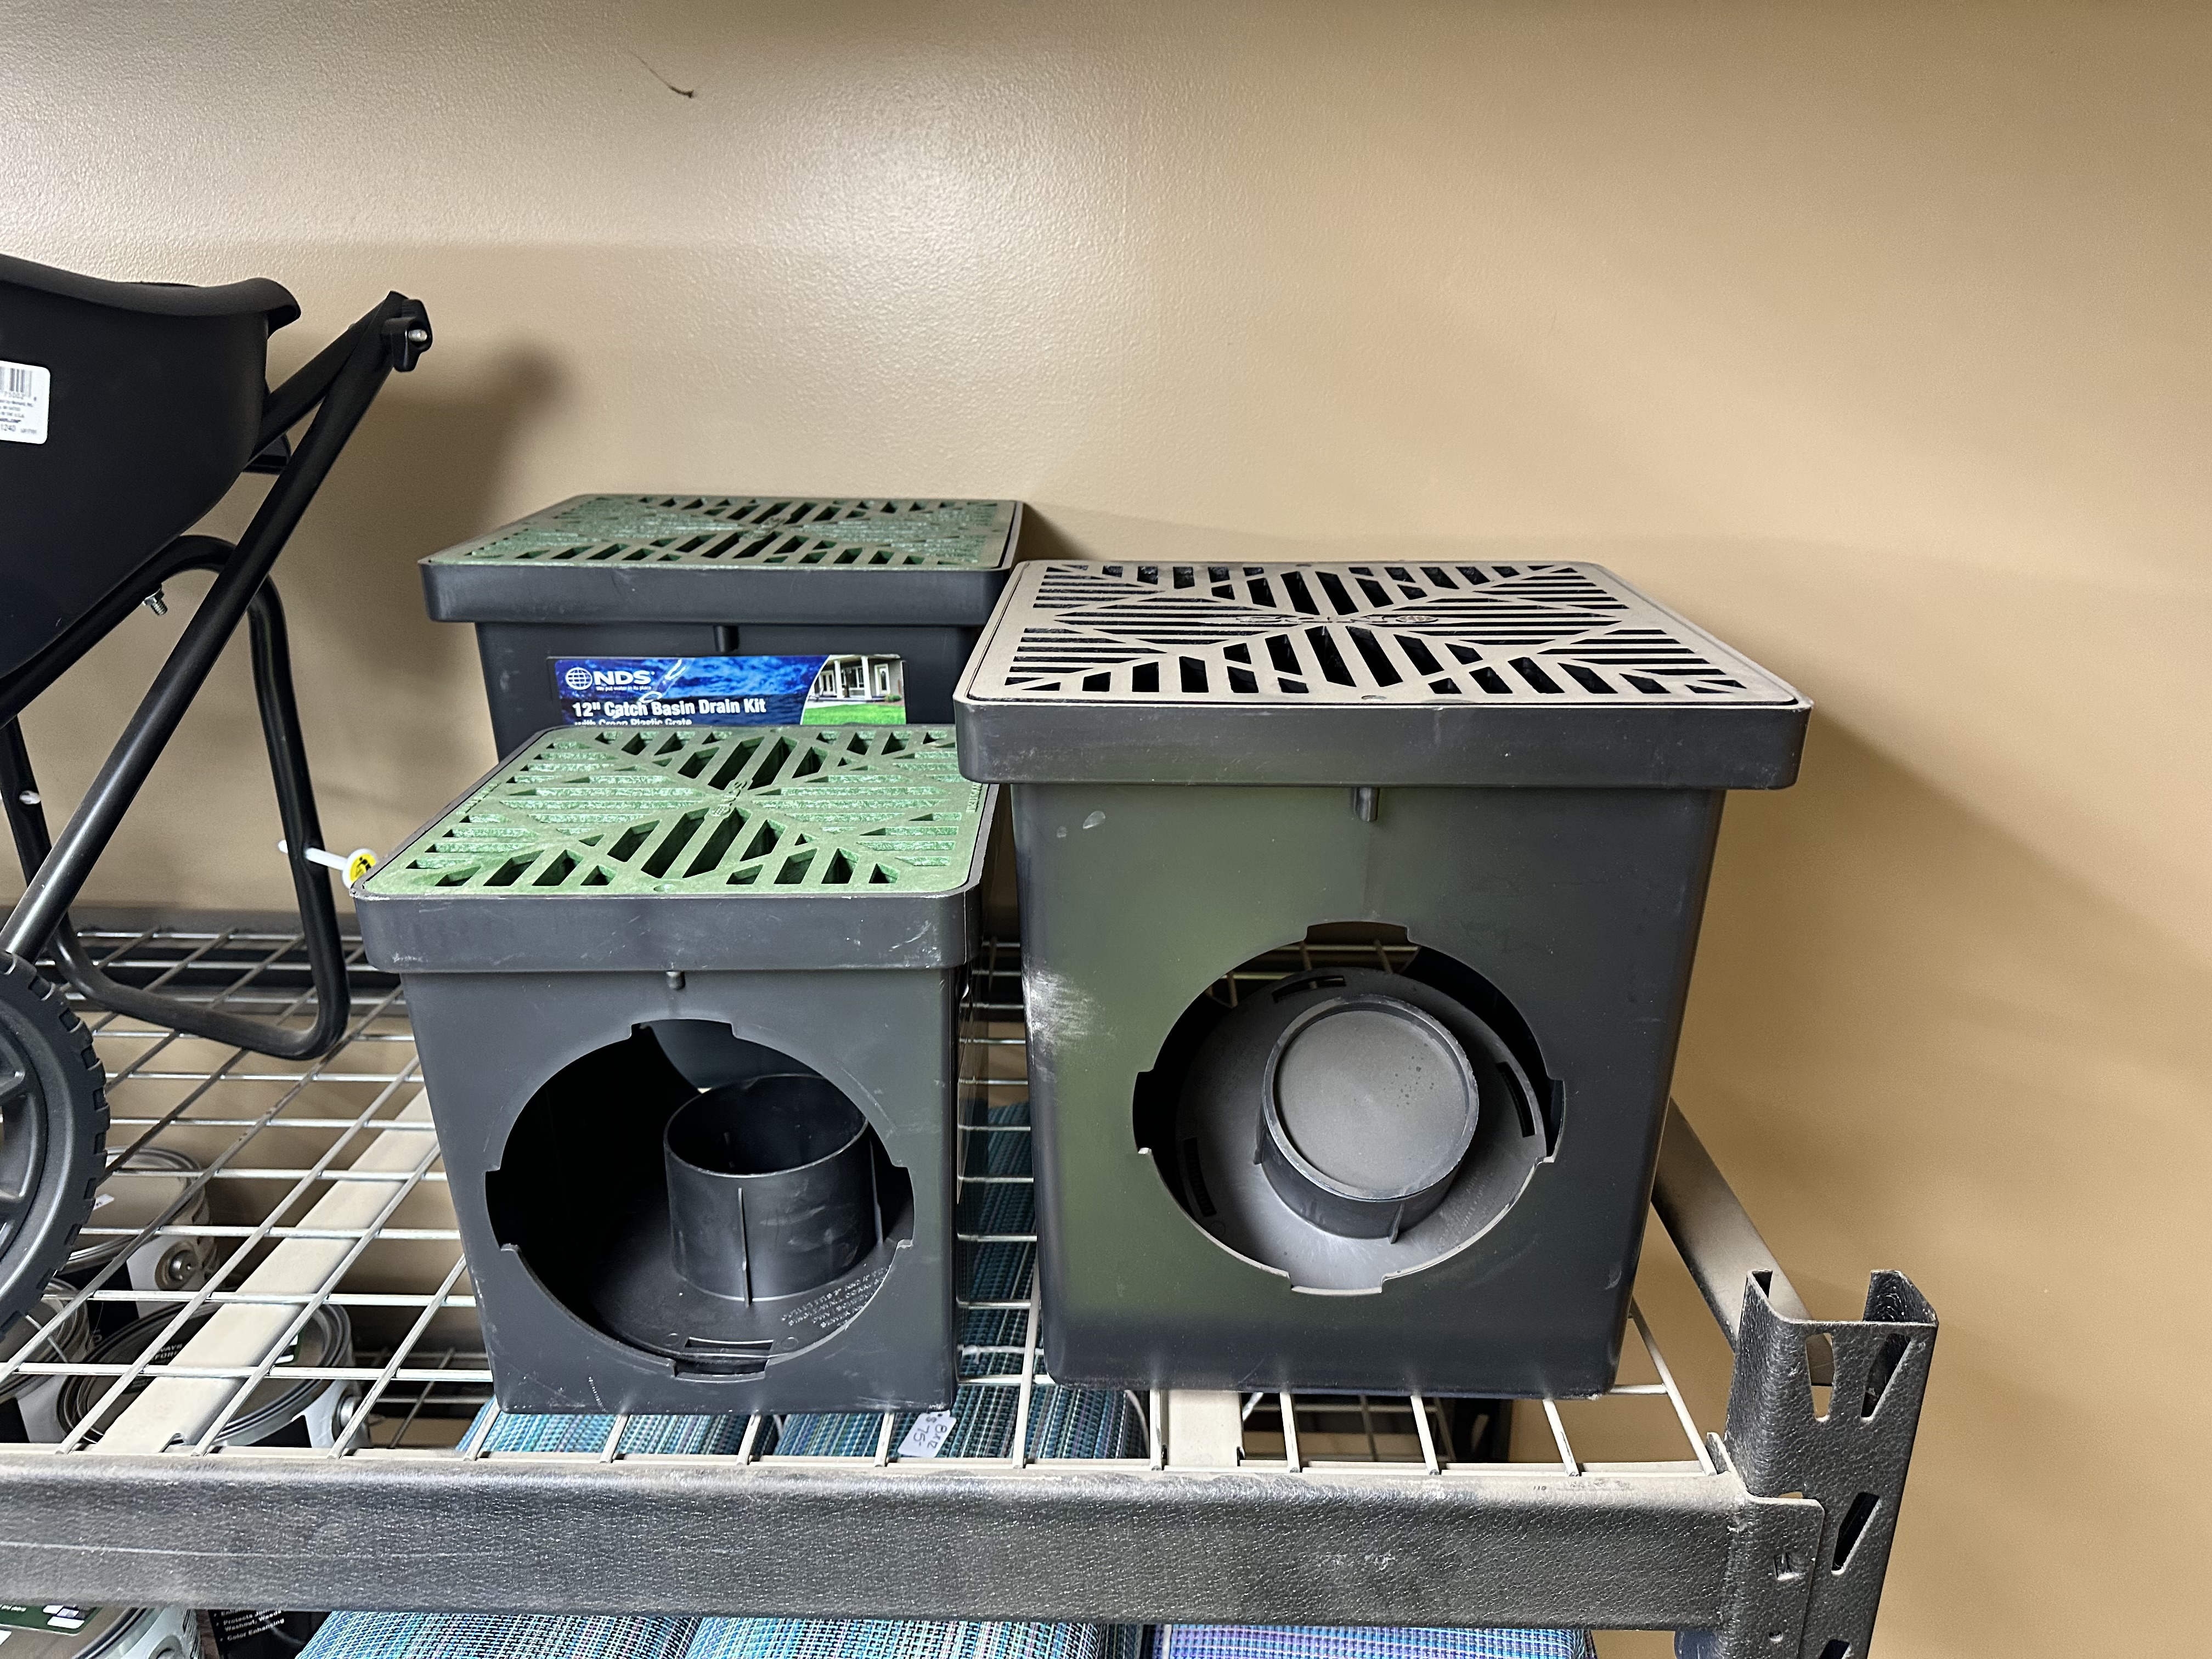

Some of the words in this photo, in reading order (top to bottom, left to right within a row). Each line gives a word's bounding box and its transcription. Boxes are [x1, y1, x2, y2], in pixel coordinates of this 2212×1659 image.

[593, 670, 651, 685] NDS
[572, 702, 601, 717] 12"
[604, 701, 648, 717] Catch
[651, 700, 696, 716] Basin
[698, 698, 740, 714] Drain
[743, 698, 766, 713] Kit
